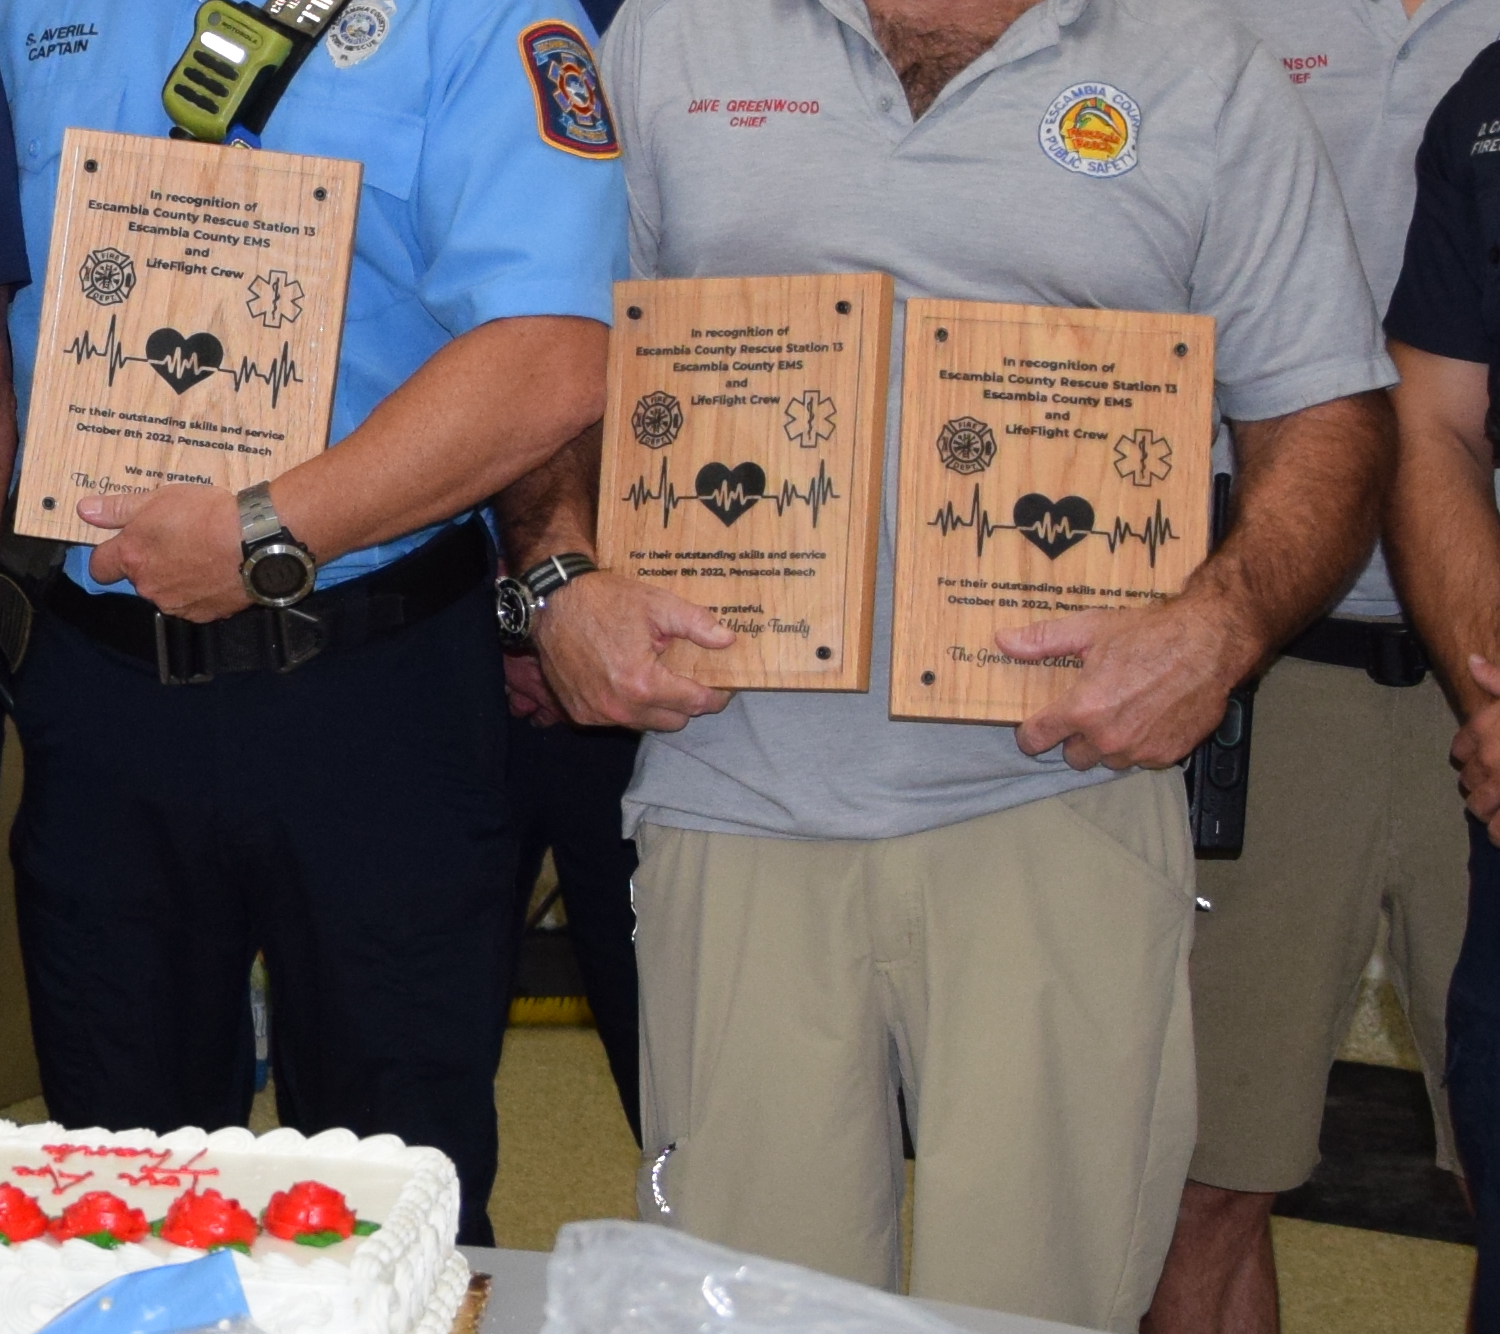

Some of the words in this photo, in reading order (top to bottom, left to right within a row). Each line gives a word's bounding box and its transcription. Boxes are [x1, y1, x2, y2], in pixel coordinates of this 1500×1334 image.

[40, 23, 99, 42] AVERILL
[222, 22, 257, 44] MOTOROLA
[28, 39, 89, 61] CAPTAIN
[1282, 55, 1328, 70] NSON
[1289, 73, 1311, 84] IEF
[688, 99, 720, 114] DAVE
[726, 100, 820, 115] GREENWOOD
[1045, 85, 1106, 125] ESCAMBIA
[729, 116, 767, 128] CHIEF
[1044, 135, 1082, 169] PUBLIC
[1087, 150, 1135, 173] SAFETY
[150, 189, 162, 200] In
[165, 193, 240, 209] recognition
[244, 202, 257, 212] of
[88, 199, 149, 215] Escambia
[152, 207, 199, 224] County
[202, 213, 249, 228] Rescue
[252, 219, 299, 234] Station
[304, 226, 315, 236] 13
[128, 221, 189, 238] Escambia
[192, 229, 240, 246] County
[243, 235, 270, 247] EMS
[101, 251, 120, 261] FIRE
[184, 247, 209, 257] and
[146, 257, 207, 275] LifeFlight
[210, 266, 244, 279] Crew
[690, 328, 702, 337] In
[705, 325, 773, 339] recognition
[776, 325, 789, 336] of
[635, 344, 691, 356] Escambia
[694, 344, 736, 356] County
[739, 344, 782, 353] Rescue
[786, 341, 828, 353] Station
[832, 342, 843, 351] 13
[672, 360, 728, 372] Escambia
[732, 361, 774, 372] County
[777, 359, 803, 369] EMS
[724, 377, 748, 387] and
[690, 394, 746, 407] LifeFlight
[749, 394, 780, 404] Crew
[68, 404, 86, 414] For
[89, 407, 115, 417] their
[118, 412, 186, 429] outstanding
[189, 420, 218, 431] skills
[220, 425, 242, 435] and
[244, 429, 284, 440] service
[76, 422, 121, 435] October
[123, 428, 142, 438] 8th
[145, 431, 174, 445] 2022,
[177, 435, 234, 451] Pensacola
[237, 443, 271, 456] Beach
[70, 472, 97, 489] The
[98, 475, 132, 495] Gross
[124, 465, 142, 475] We
[145, 469, 163, 478] are
[166, 472, 213, 486] grateful,
[43, 1144, 219, 1178] Thank
